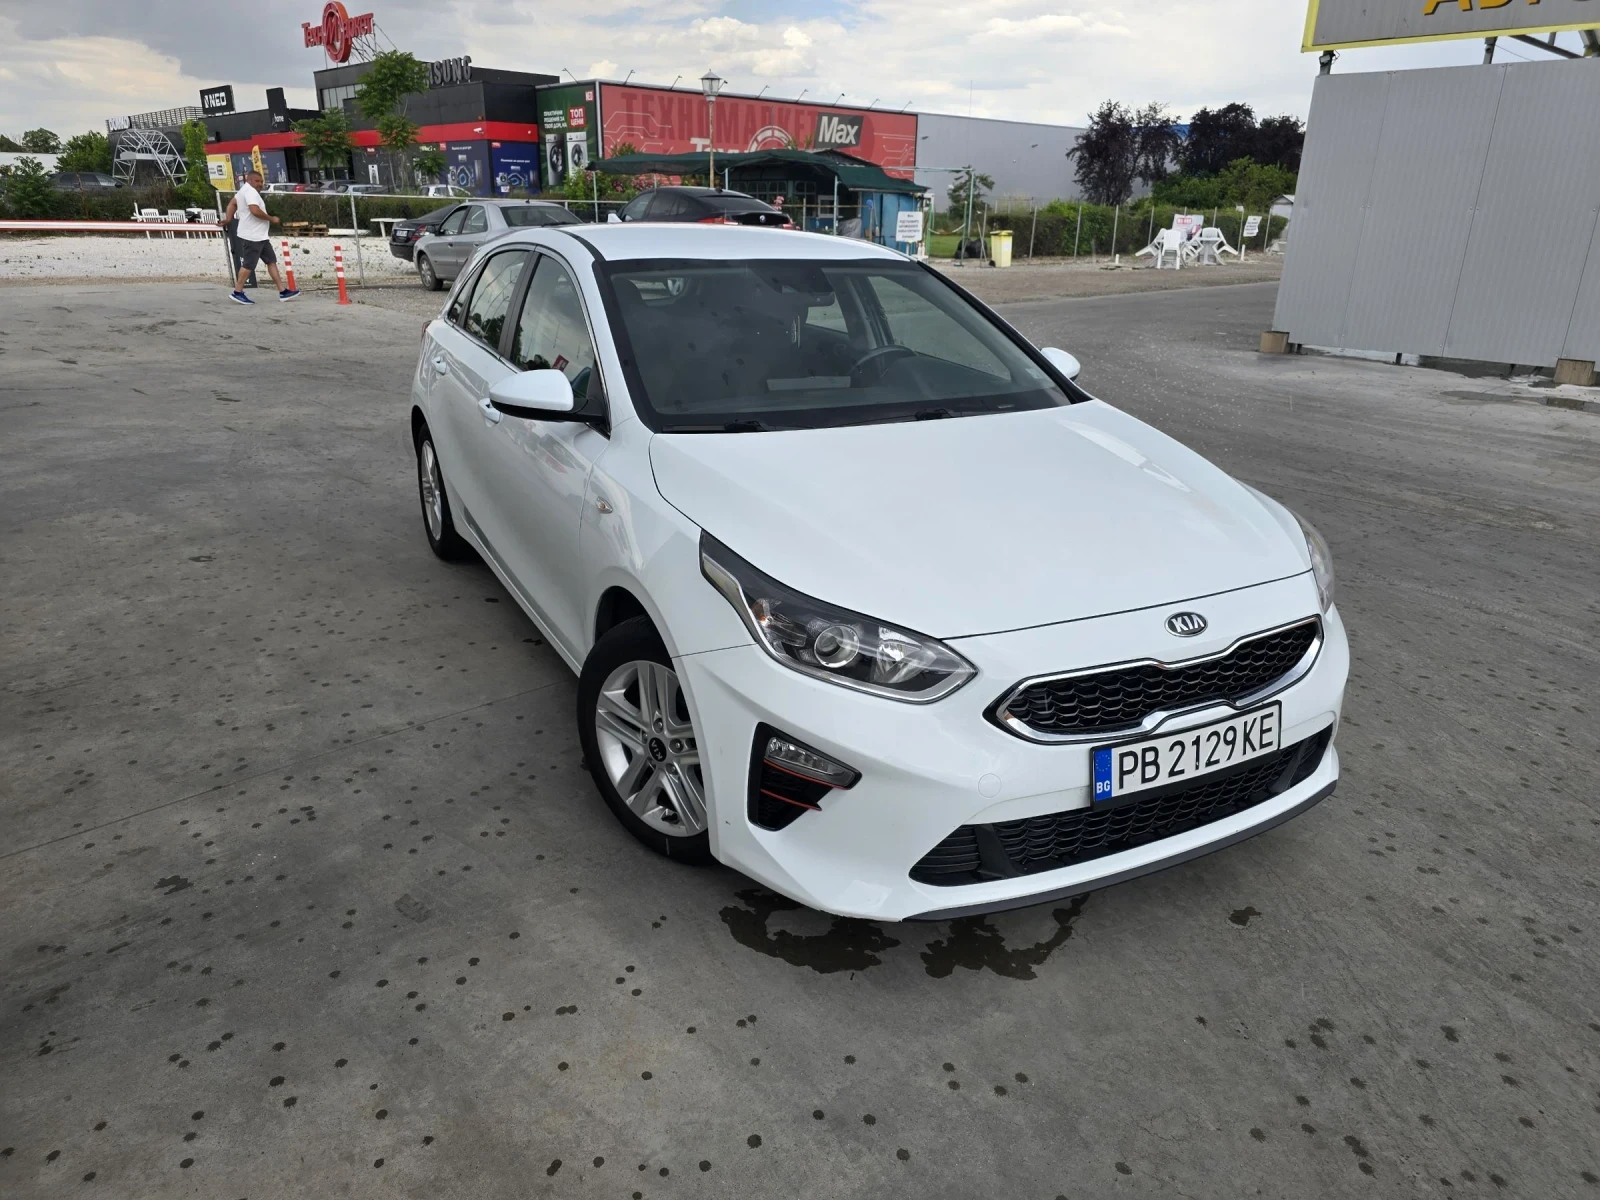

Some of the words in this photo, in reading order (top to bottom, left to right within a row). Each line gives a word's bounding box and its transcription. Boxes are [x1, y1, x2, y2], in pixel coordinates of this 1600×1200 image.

[208, 91, 227, 108] NEO
[569, 108, 584, 118] ТОП
[570, 118, 584, 126] ЦЕНИ
[819, 115, 859, 144] Max
[1170, 614, 1205, 633] KIA
[651, 740, 663, 760] KIA
[1096, 780, 1111, 794] BG
